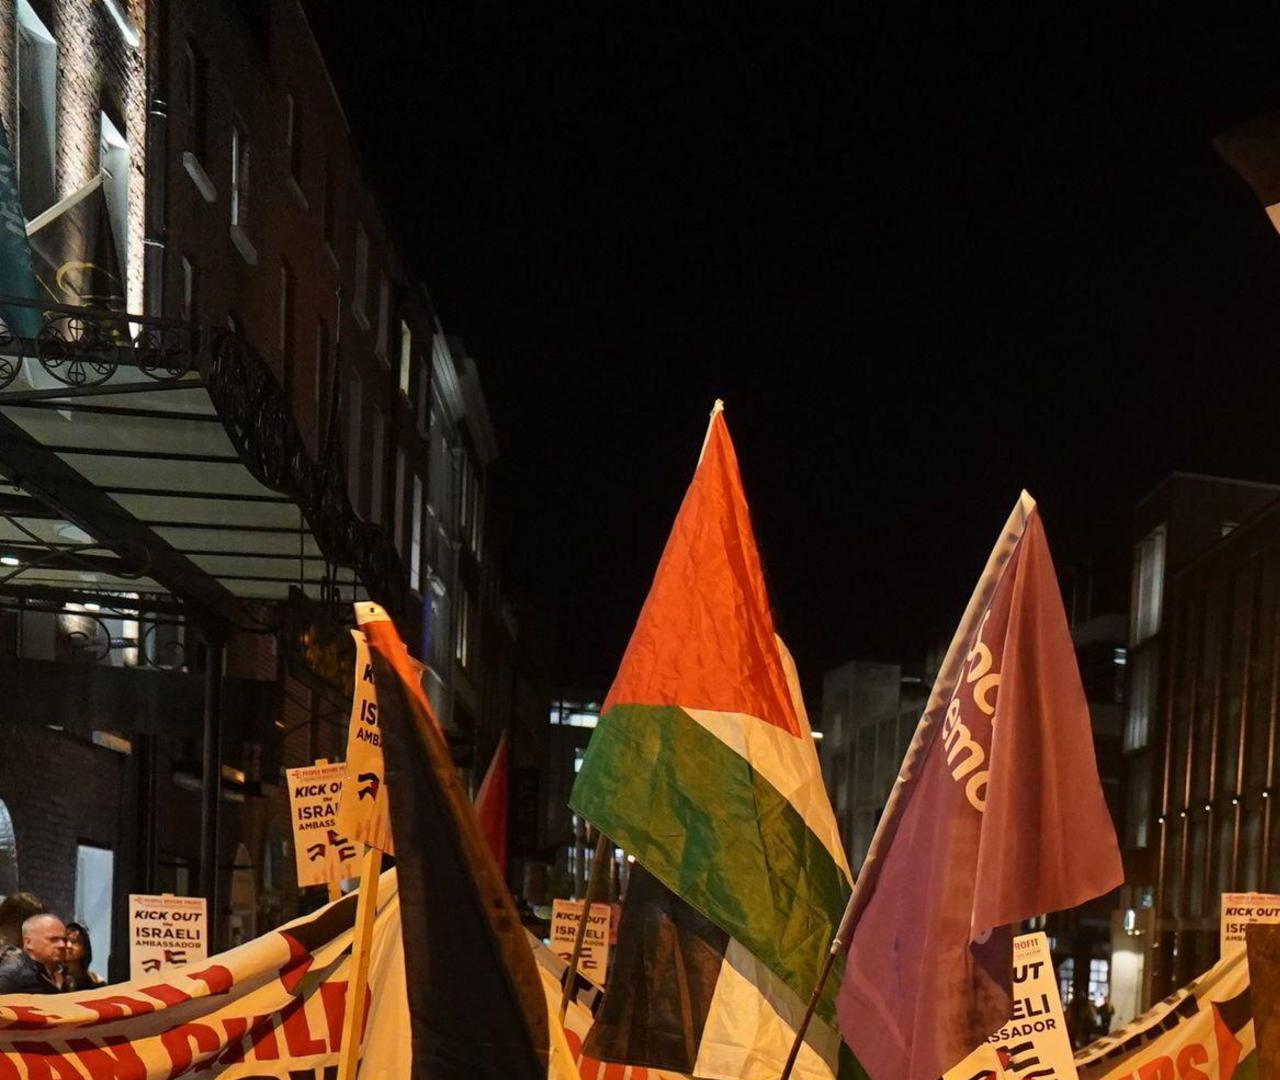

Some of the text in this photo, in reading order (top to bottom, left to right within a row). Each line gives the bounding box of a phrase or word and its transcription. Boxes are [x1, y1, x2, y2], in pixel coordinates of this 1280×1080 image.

[295, 784, 326, 799] KICK
[298, 803, 338, 820] ISRA
[134, 910, 202, 922] KICK OUT
[1226, 907, 1253, 917] KICK
[136, 927, 201, 940] ISRAELI
[1226, 923, 1246, 934] ISR
[135, 939, 202, 949] AMBASSADOR
[1014, 938, 1040, 951] ROFIT
[1013, 961, 1044, 984] UT
[1010, 993, 1051, 1021] ELI
